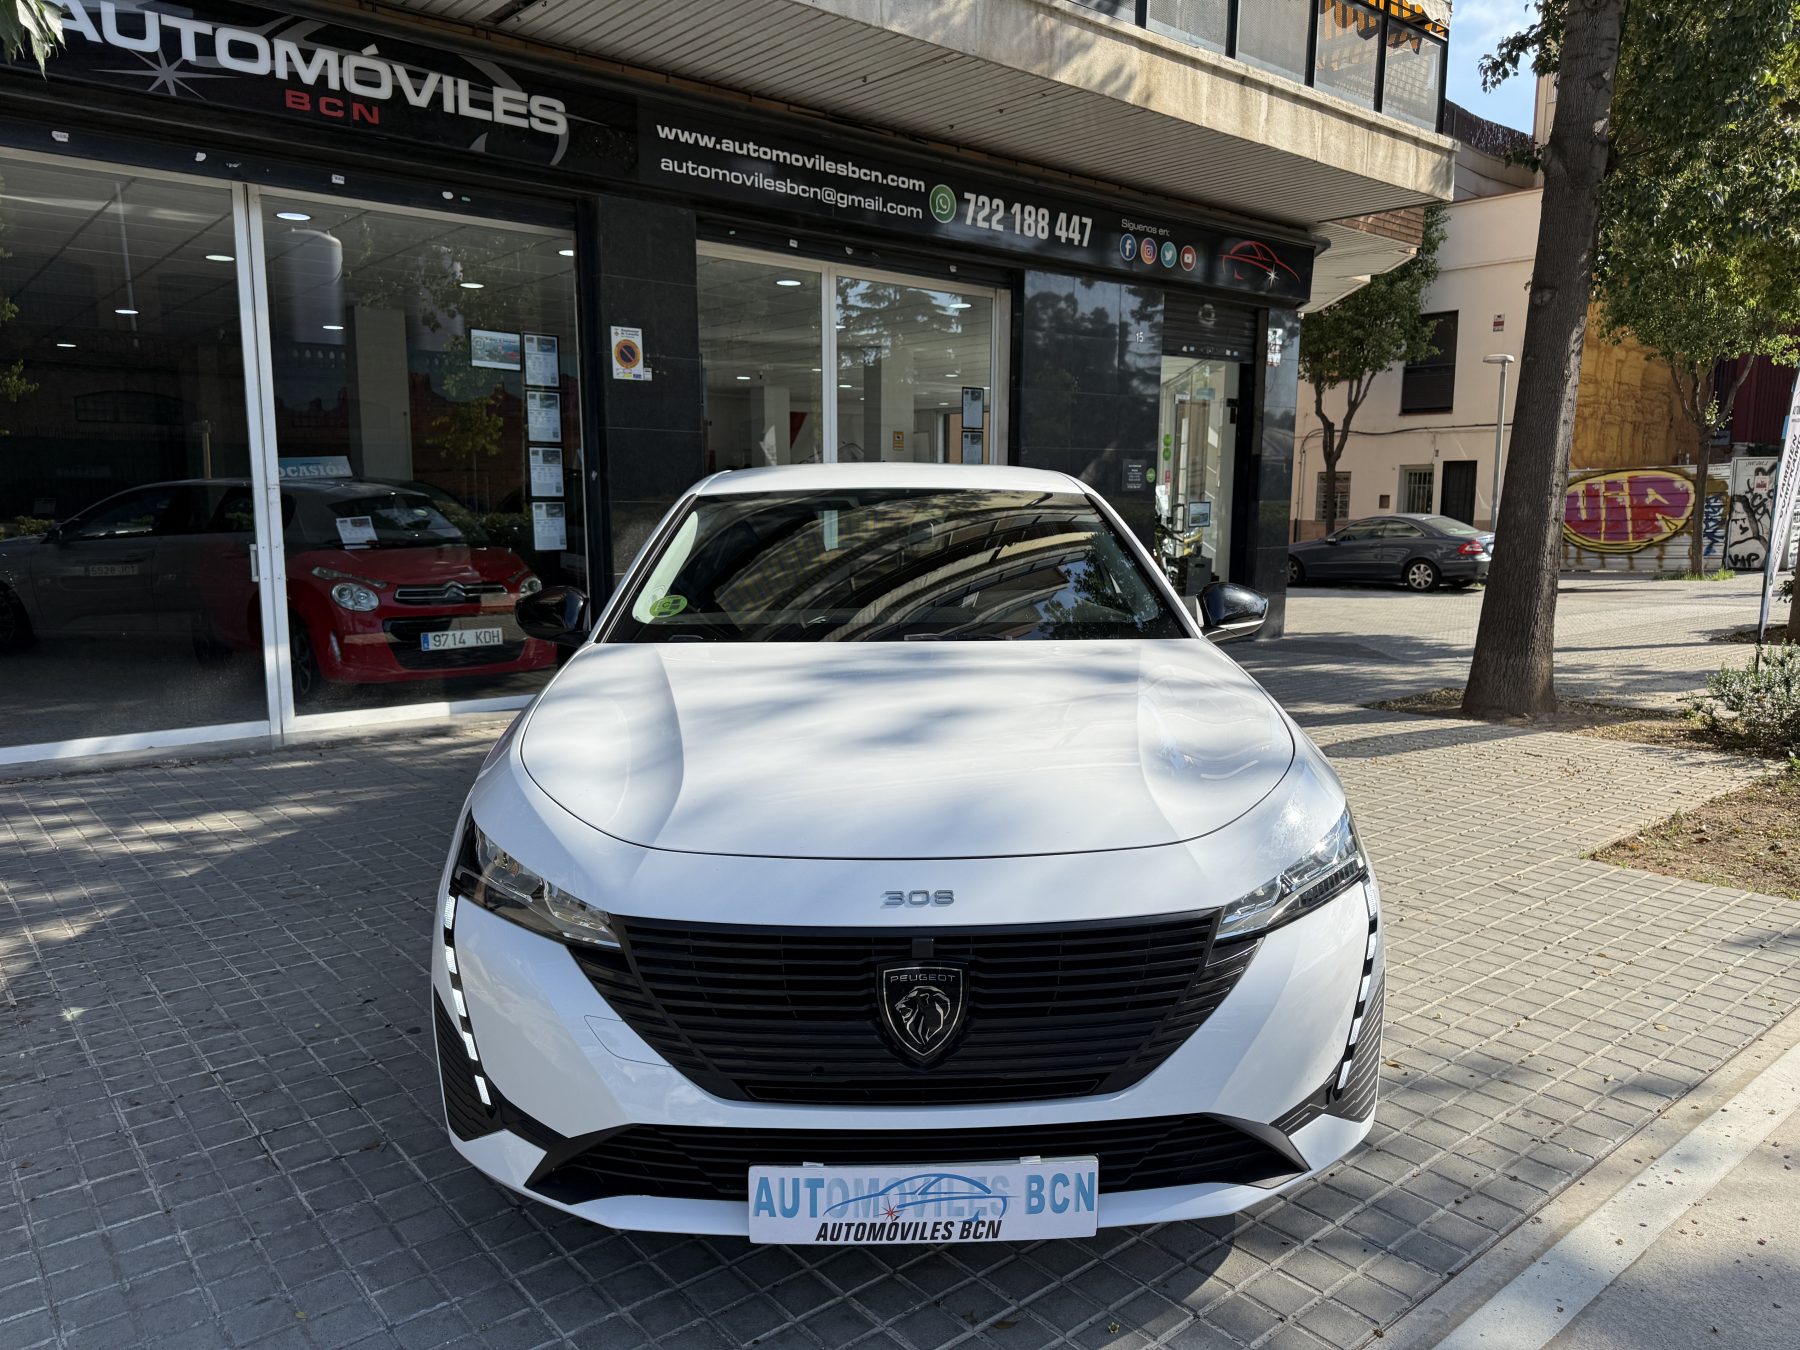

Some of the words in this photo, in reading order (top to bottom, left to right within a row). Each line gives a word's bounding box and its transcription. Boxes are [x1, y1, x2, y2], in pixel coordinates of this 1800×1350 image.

[285, 90, 379, 124] BCN
[656, 124, 926, 193] www.automovilesbcn.com
[660, 157, 923, 219] automovilesbcn@gmail.com
[963, 192, 1005, 231] 722
[1010, 202, 1050, 240] 188
[1054, 212, 1093, 247] 447
[1120, 218, 1158, 235] Síguenos
[1158, 228, 1171, 237] en:
[1136, 331, 1144, 343] 15
[433, 632, 466, 647] 9714
[884, 889, 955, 906] 308
[889, 973, 957, 984] PEUGEOT
[1023, 1171, 1096, 1215] BCN
[958, 1219, 1003, 1240] BCN
